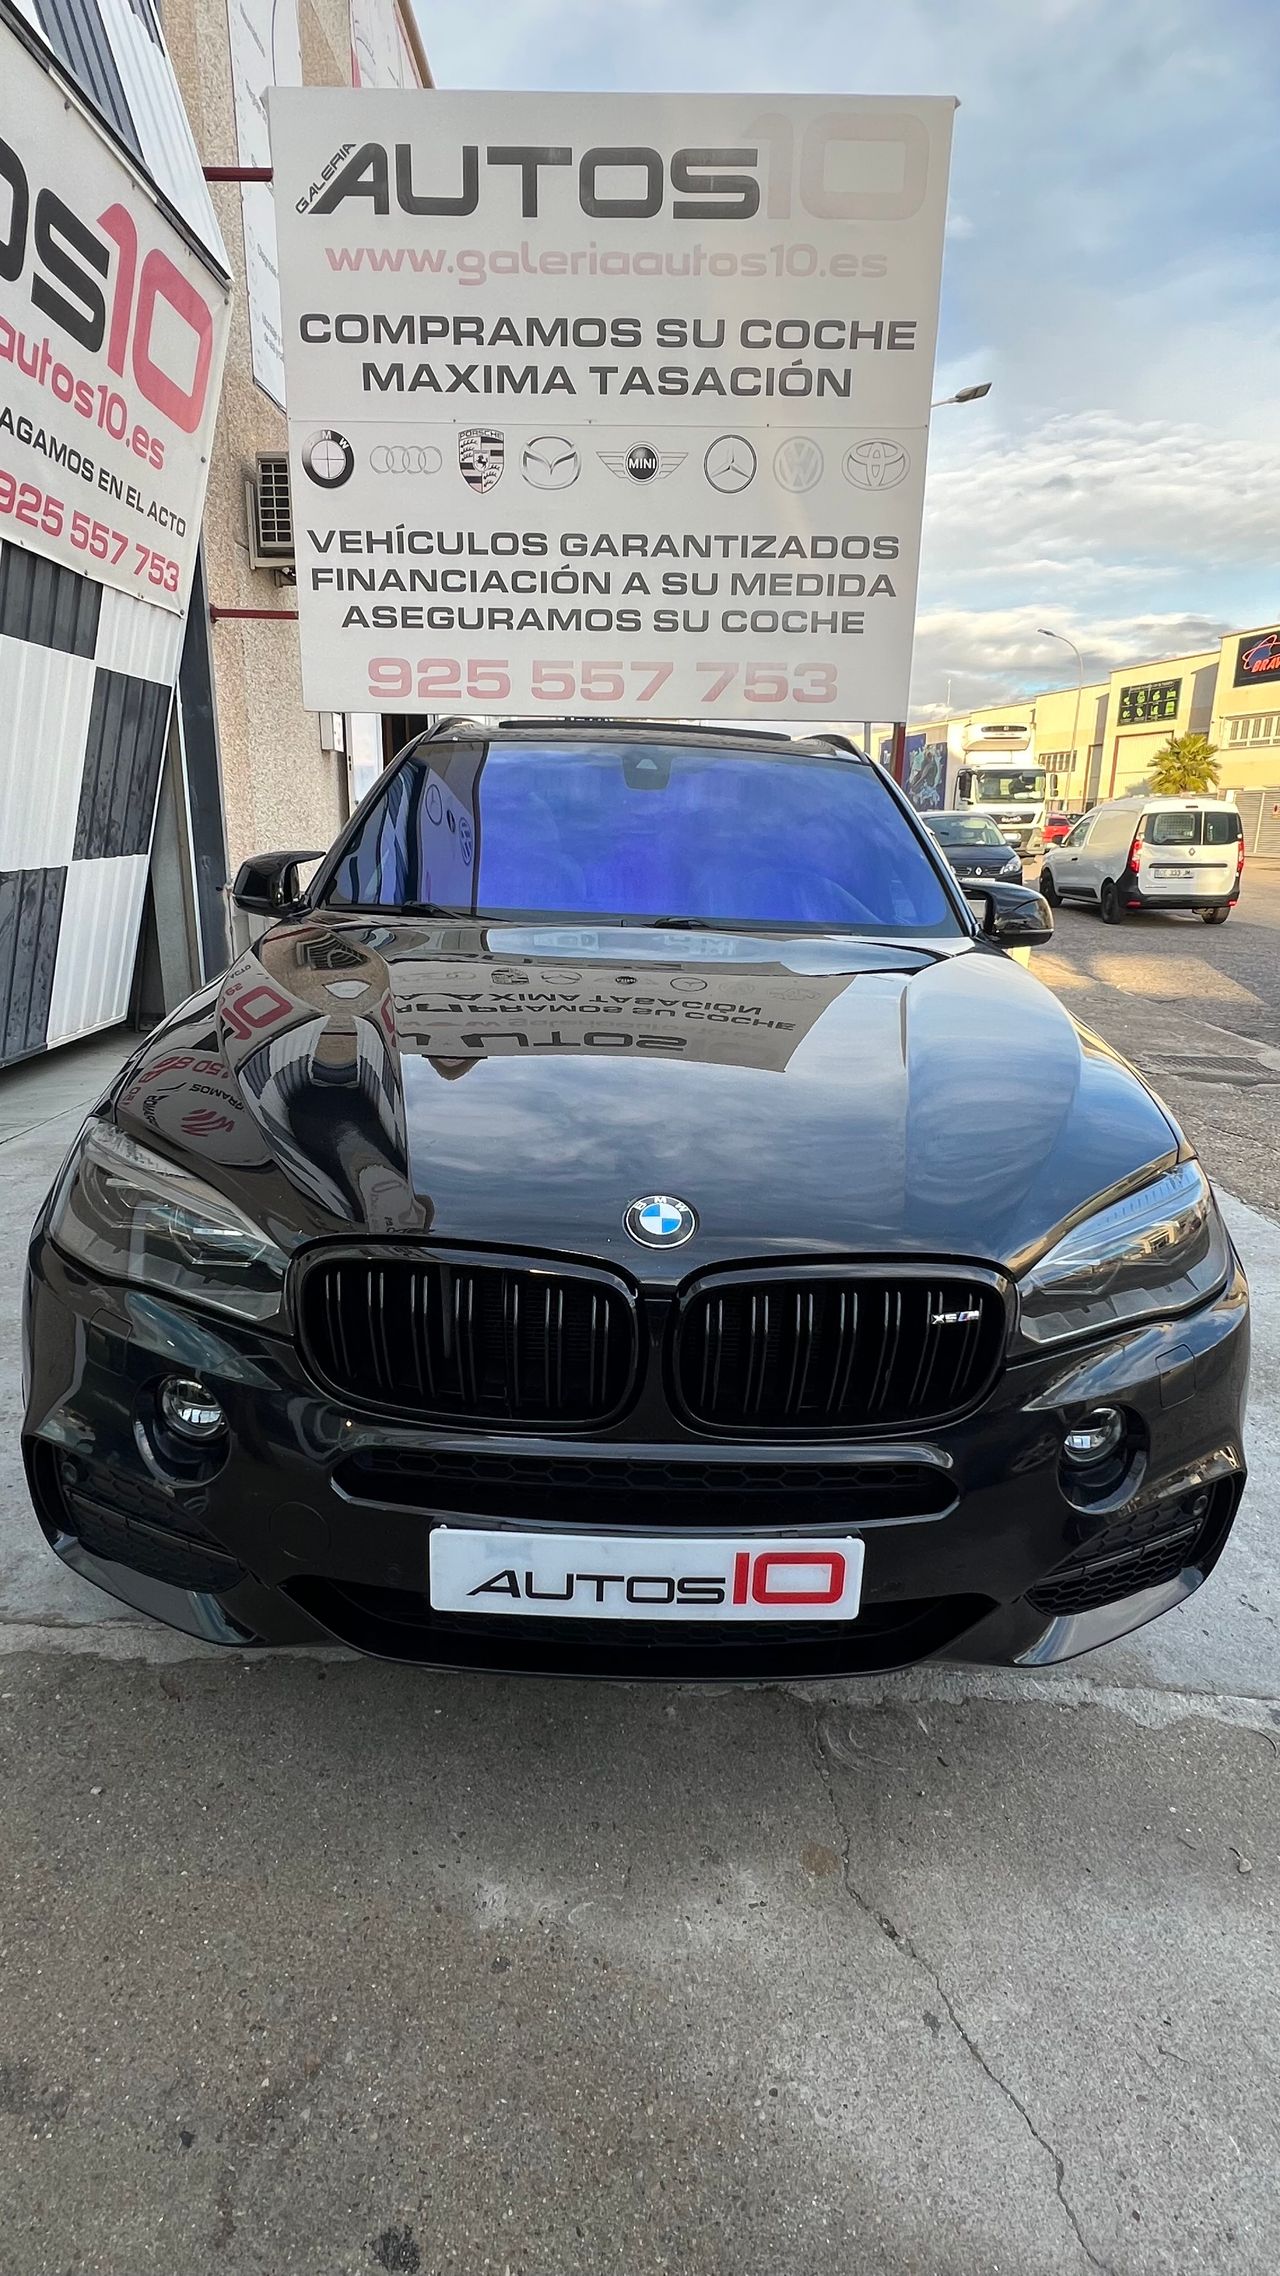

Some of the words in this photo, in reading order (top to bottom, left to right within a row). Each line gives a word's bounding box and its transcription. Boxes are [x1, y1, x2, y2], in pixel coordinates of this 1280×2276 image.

[295, 142, 357, 214] GALERIA
[308, 112, 930, 220] AUTOS10
[325, 243, 887, 286] www.galeriaautos10.es
[299, 313, 642, 349] COMPRAMOS
[656, 317, 725, 349] SU
[740, 319, 917, 350] COCHE
[362, 362, 577, 396] MAXIMA
[589, 359, 852, 398] TASACIÓN
[628, 457, 656, 469] MINI
[98, 467, 124, 500] EN
[126, 485, 144, 514] EL
[147, 500, 186, 538] ACTO
[70, 509, 129, 565] 557
[133, 542, 180, 592] 753
[306, 523, 549, 557] VEHÍCULOS
[559, 531, 900, 561] GARANTIZADOS
[310, 564, 612, 597] FINANCIACIÓN
[621, 572, 652, 597] A
[661, 572, 718, 597] SU
[730, 573, 898, 599] MEDIDA
[340, 604, 642, 633] ASEGURAMOS
[653, 608, 709, 633] SU
[720, 609, 865, 635] COCHE
[367, 656, 511, 700] 925
[531, 660, 674, 703] 557
[695, 662, 838, 704] 753
[633, 1196, 689, 1212] BMW
[466, 1551, 846, 1606] AUTOS10
